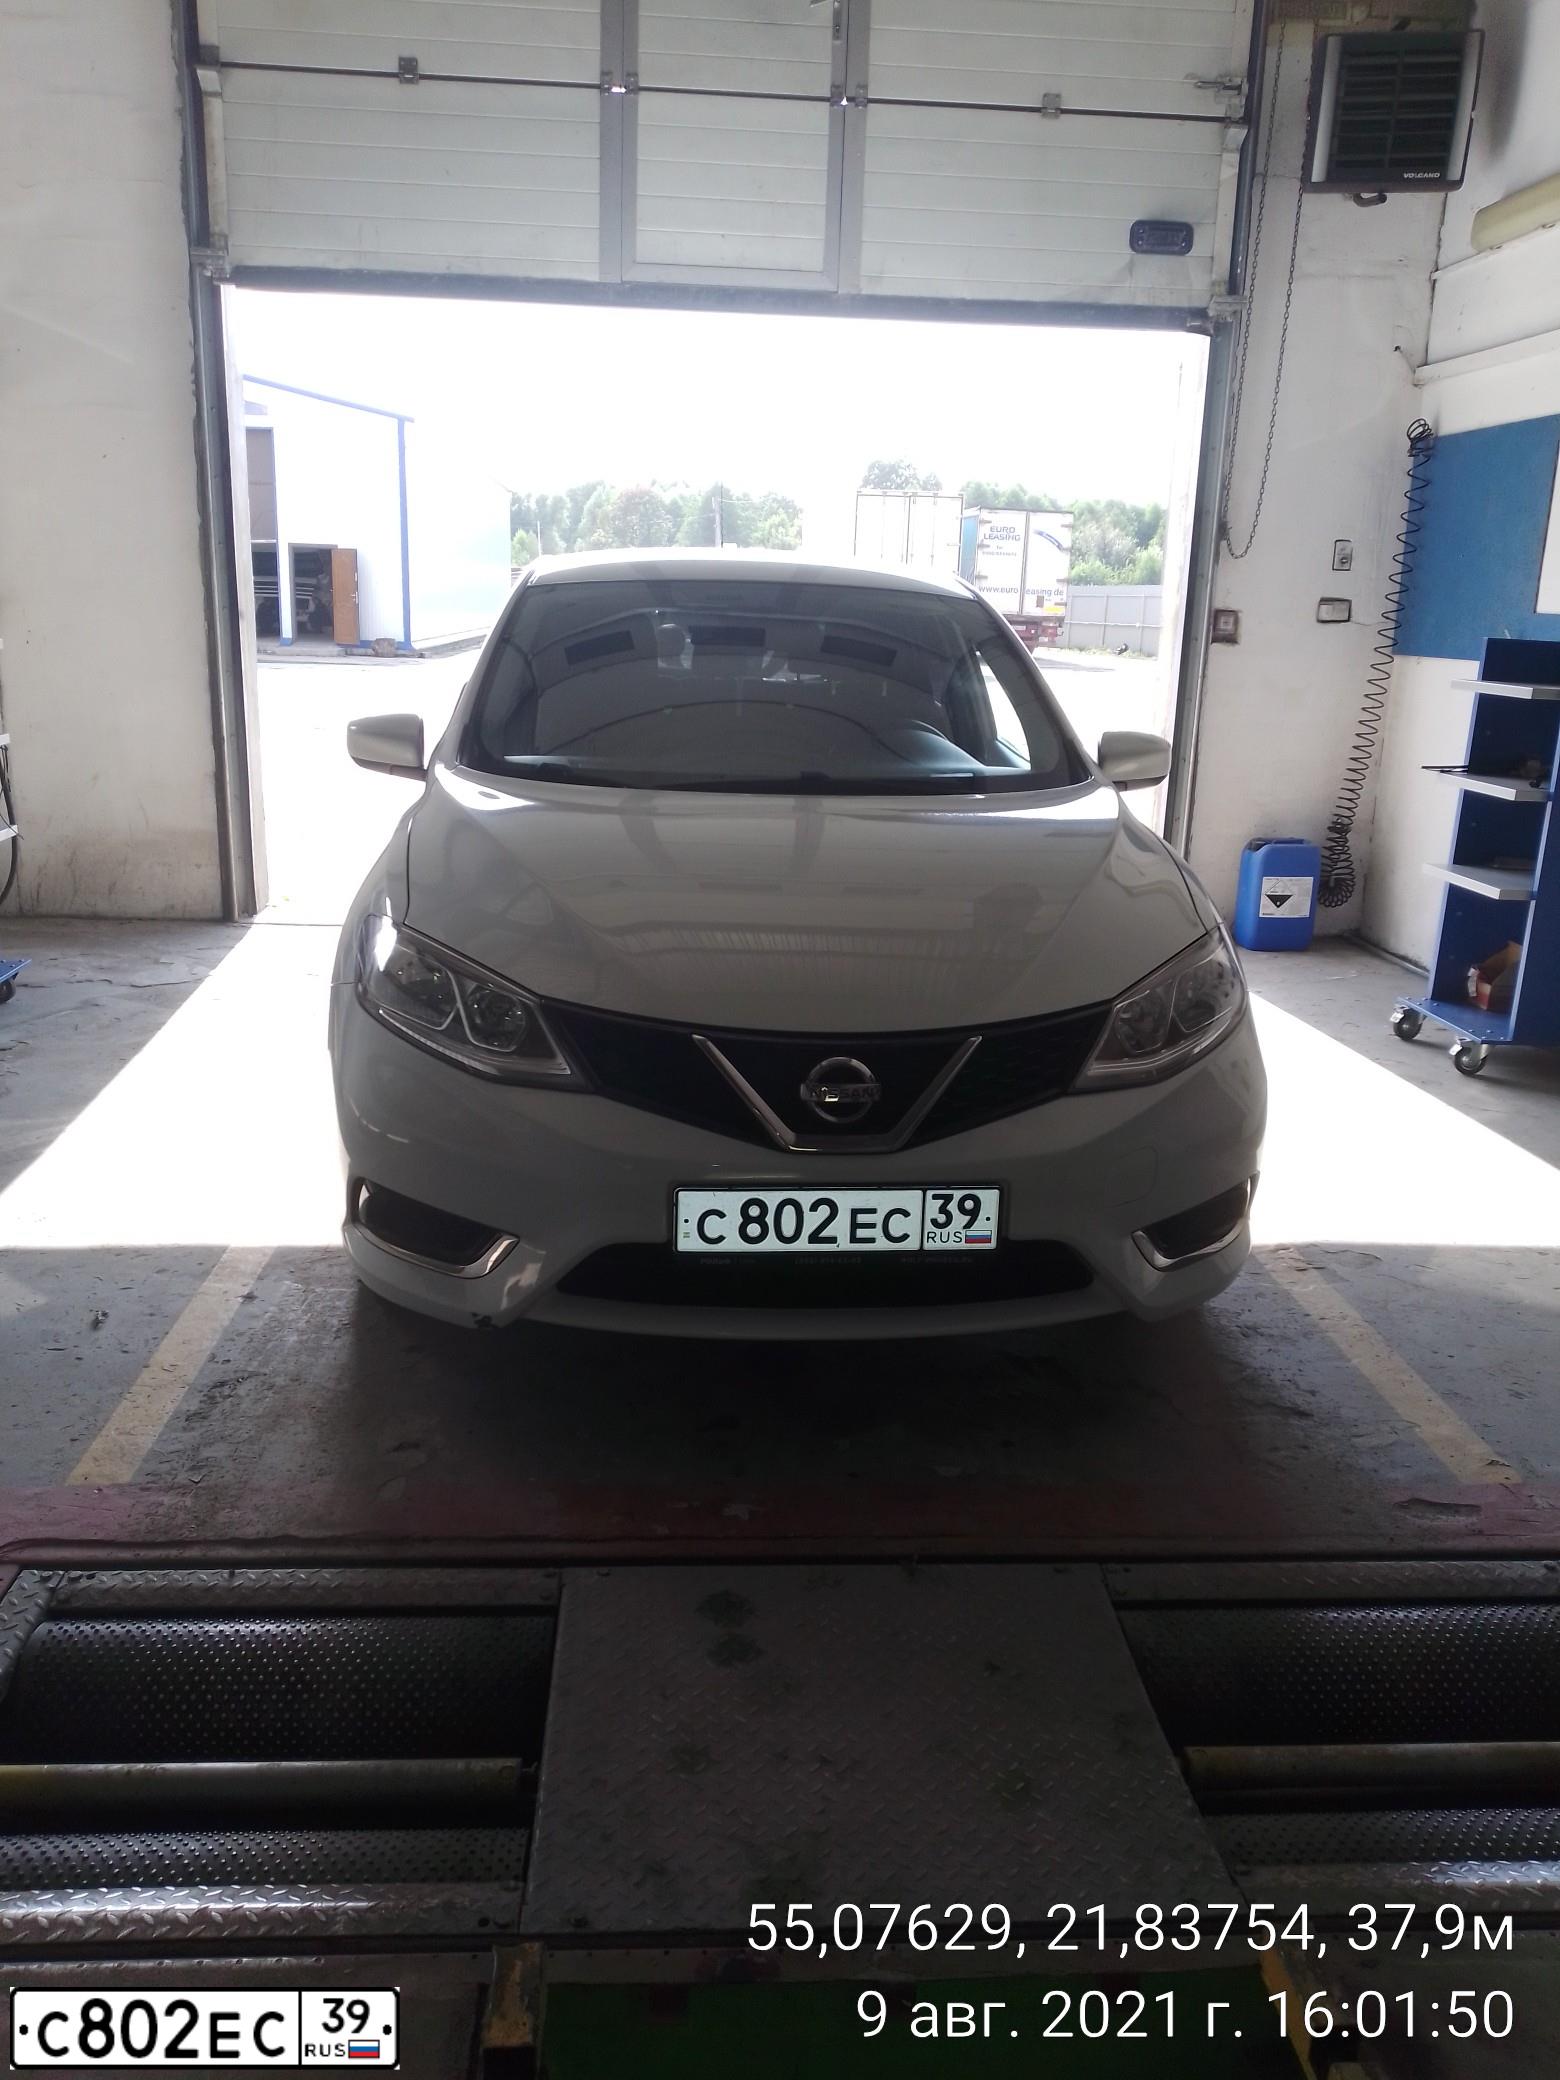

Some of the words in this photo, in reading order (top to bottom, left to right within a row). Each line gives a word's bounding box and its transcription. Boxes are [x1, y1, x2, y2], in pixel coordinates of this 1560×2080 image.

[983, 533, 1021, 541] LEASING
[930, 1193, 982, 1230] 39
[926, 1231, 963, 1244] RUS
